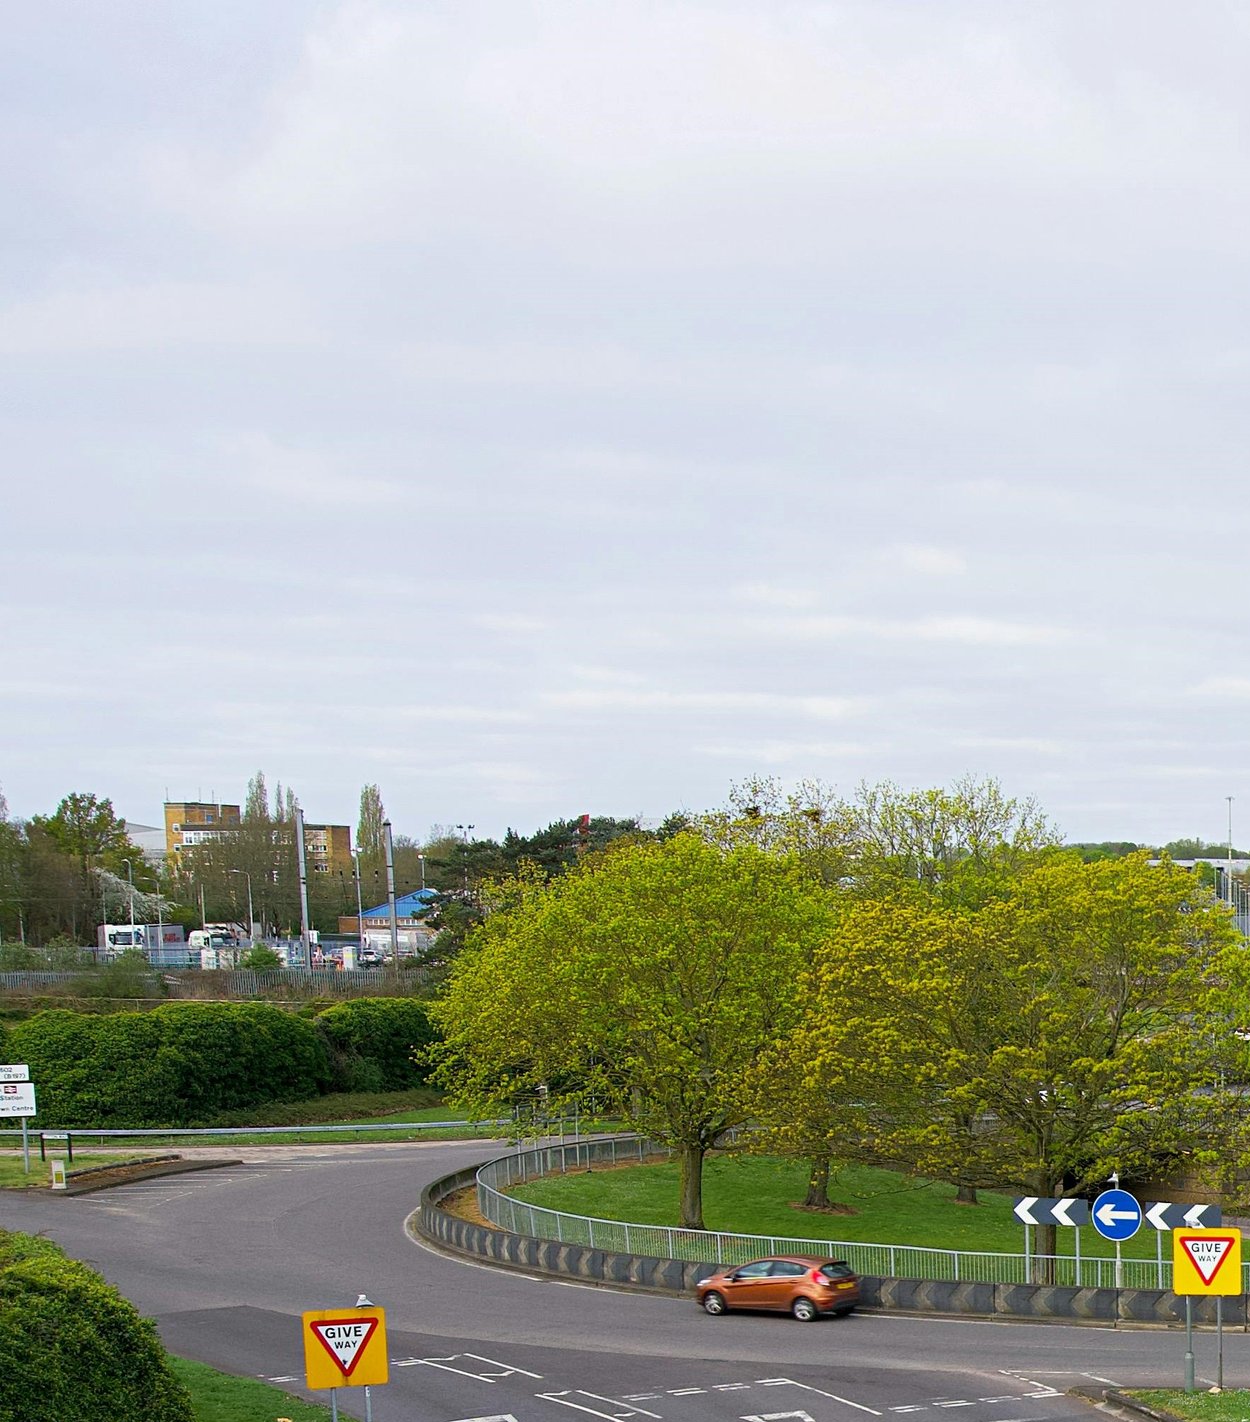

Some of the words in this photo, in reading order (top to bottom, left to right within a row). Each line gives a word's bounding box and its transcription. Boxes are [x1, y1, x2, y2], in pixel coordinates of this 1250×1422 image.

[1191, 1243, 1221, 1253] GIVE
[325, 1326, 362, 1338] GIVE
[335, 1340, 357, 1349] WAY
